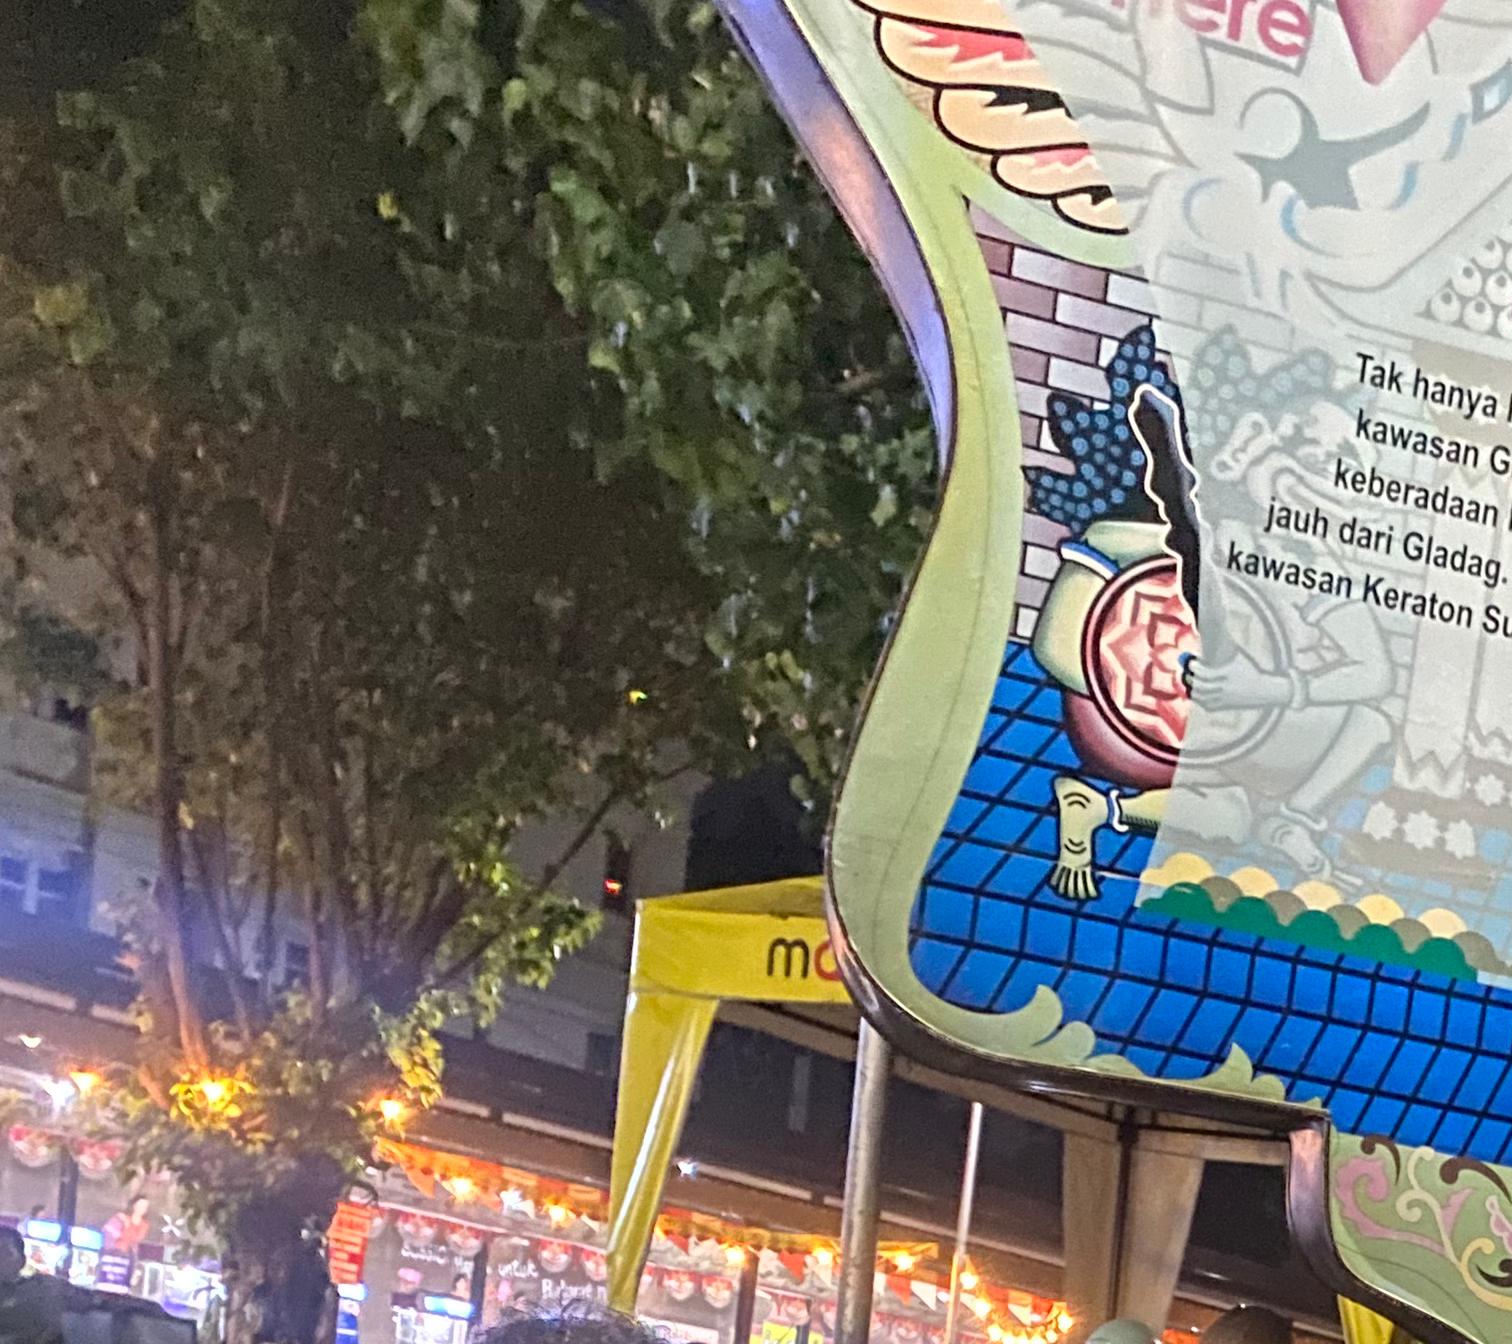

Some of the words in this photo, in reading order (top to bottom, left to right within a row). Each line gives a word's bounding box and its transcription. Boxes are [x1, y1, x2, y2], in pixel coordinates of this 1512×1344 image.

[1356, 352, 1403, 394] Tak
[1412, 367, 1498, 420] hanya
[1356, 407, 1479, 468] kawasan
[1334, 457, 1499, 527] keberadaan
[1263, 496, 1329, 539] jauh
[1339, 517, 1394, 555] dari
[1403, 531, 1507, 589] Gladag.
[1226, 540, 1353, 599] kawasan
[1362, 573, 1473, 628] Keraton
